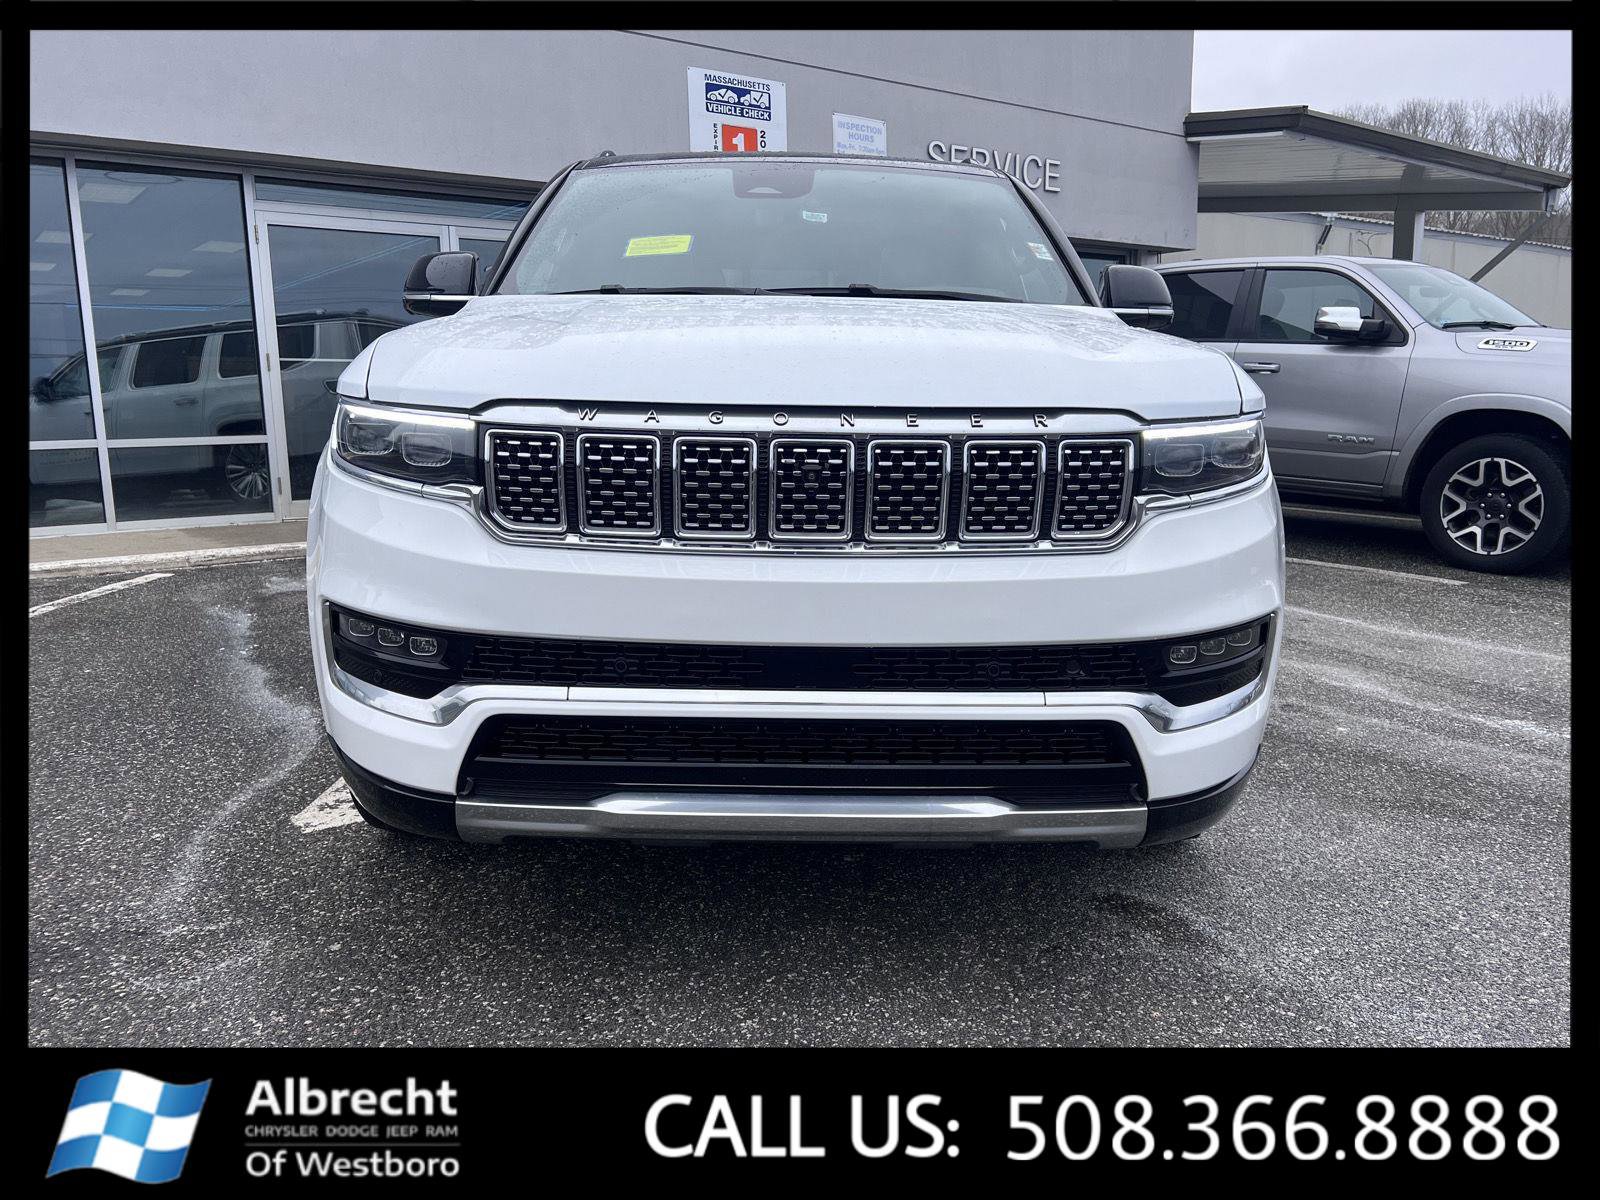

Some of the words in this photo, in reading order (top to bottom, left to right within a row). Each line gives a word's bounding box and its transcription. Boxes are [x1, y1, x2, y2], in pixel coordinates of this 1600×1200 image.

[704, 73, 771, 92] MASSACHUSETTS
[707, 102, 742, 116] VEHICLE
[743, 108, 770, 120] CHECK
[837, 120, 883, 135] INSPECTION
[732, 132, 745, 151] 1
[848, 131, 874, 143] HOURS
[577, 407, 1049, 428] WAGONEER
[1327, 433, 1375, 444] RAM
